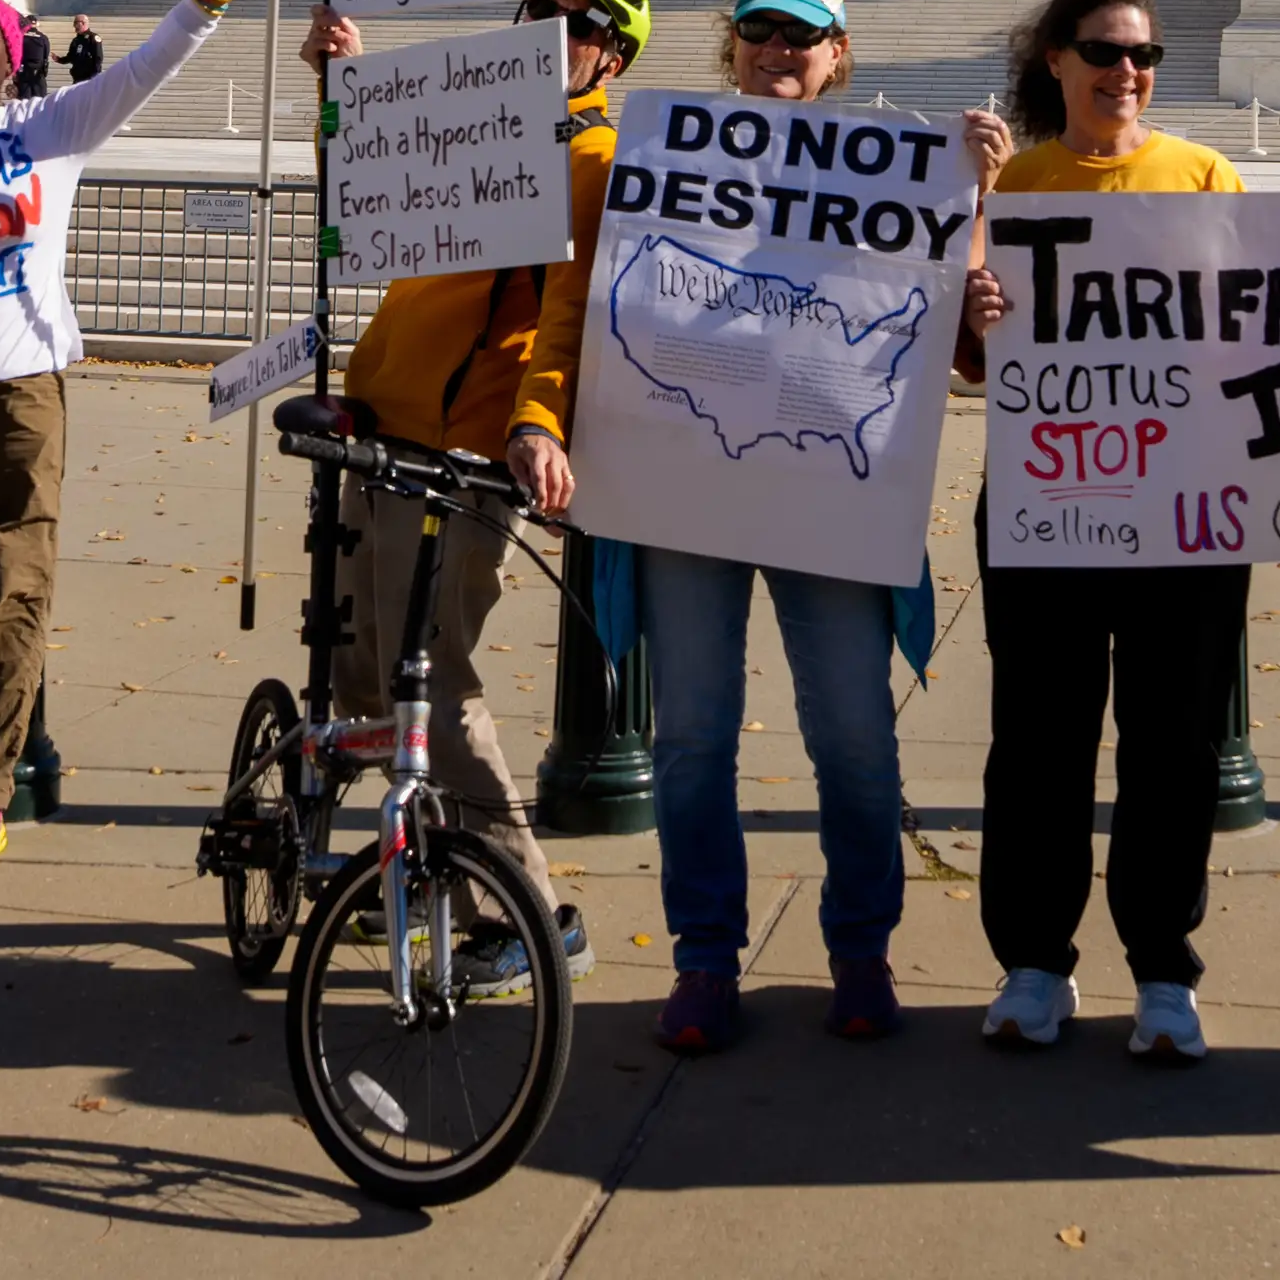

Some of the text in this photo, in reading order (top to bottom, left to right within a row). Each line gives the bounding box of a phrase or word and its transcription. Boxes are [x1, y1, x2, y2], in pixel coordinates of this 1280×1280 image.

[342, 47, 553, 123] Speaker Johnson is
[342, 103, 524, 167] Such a Hypocrite
[663, 103, 947, 183] DO NOT
[191, 198, 244, 208] AREA CLOSED
[339, 162, 540, 219] Even Jesus Wants
[605, 163, 968, 262] DESTROY
[338, 223, 482, 276] to Slap Him
[658, 257, 697, 301] We
[733, 273, 826, 328] People
[996, 360, 1192, 415] SCOTUS
[1023, 418, 1168, 482] STOP
[1009, 506, 1140, 554] Selling
[1174, 484, 1250, 553] US
